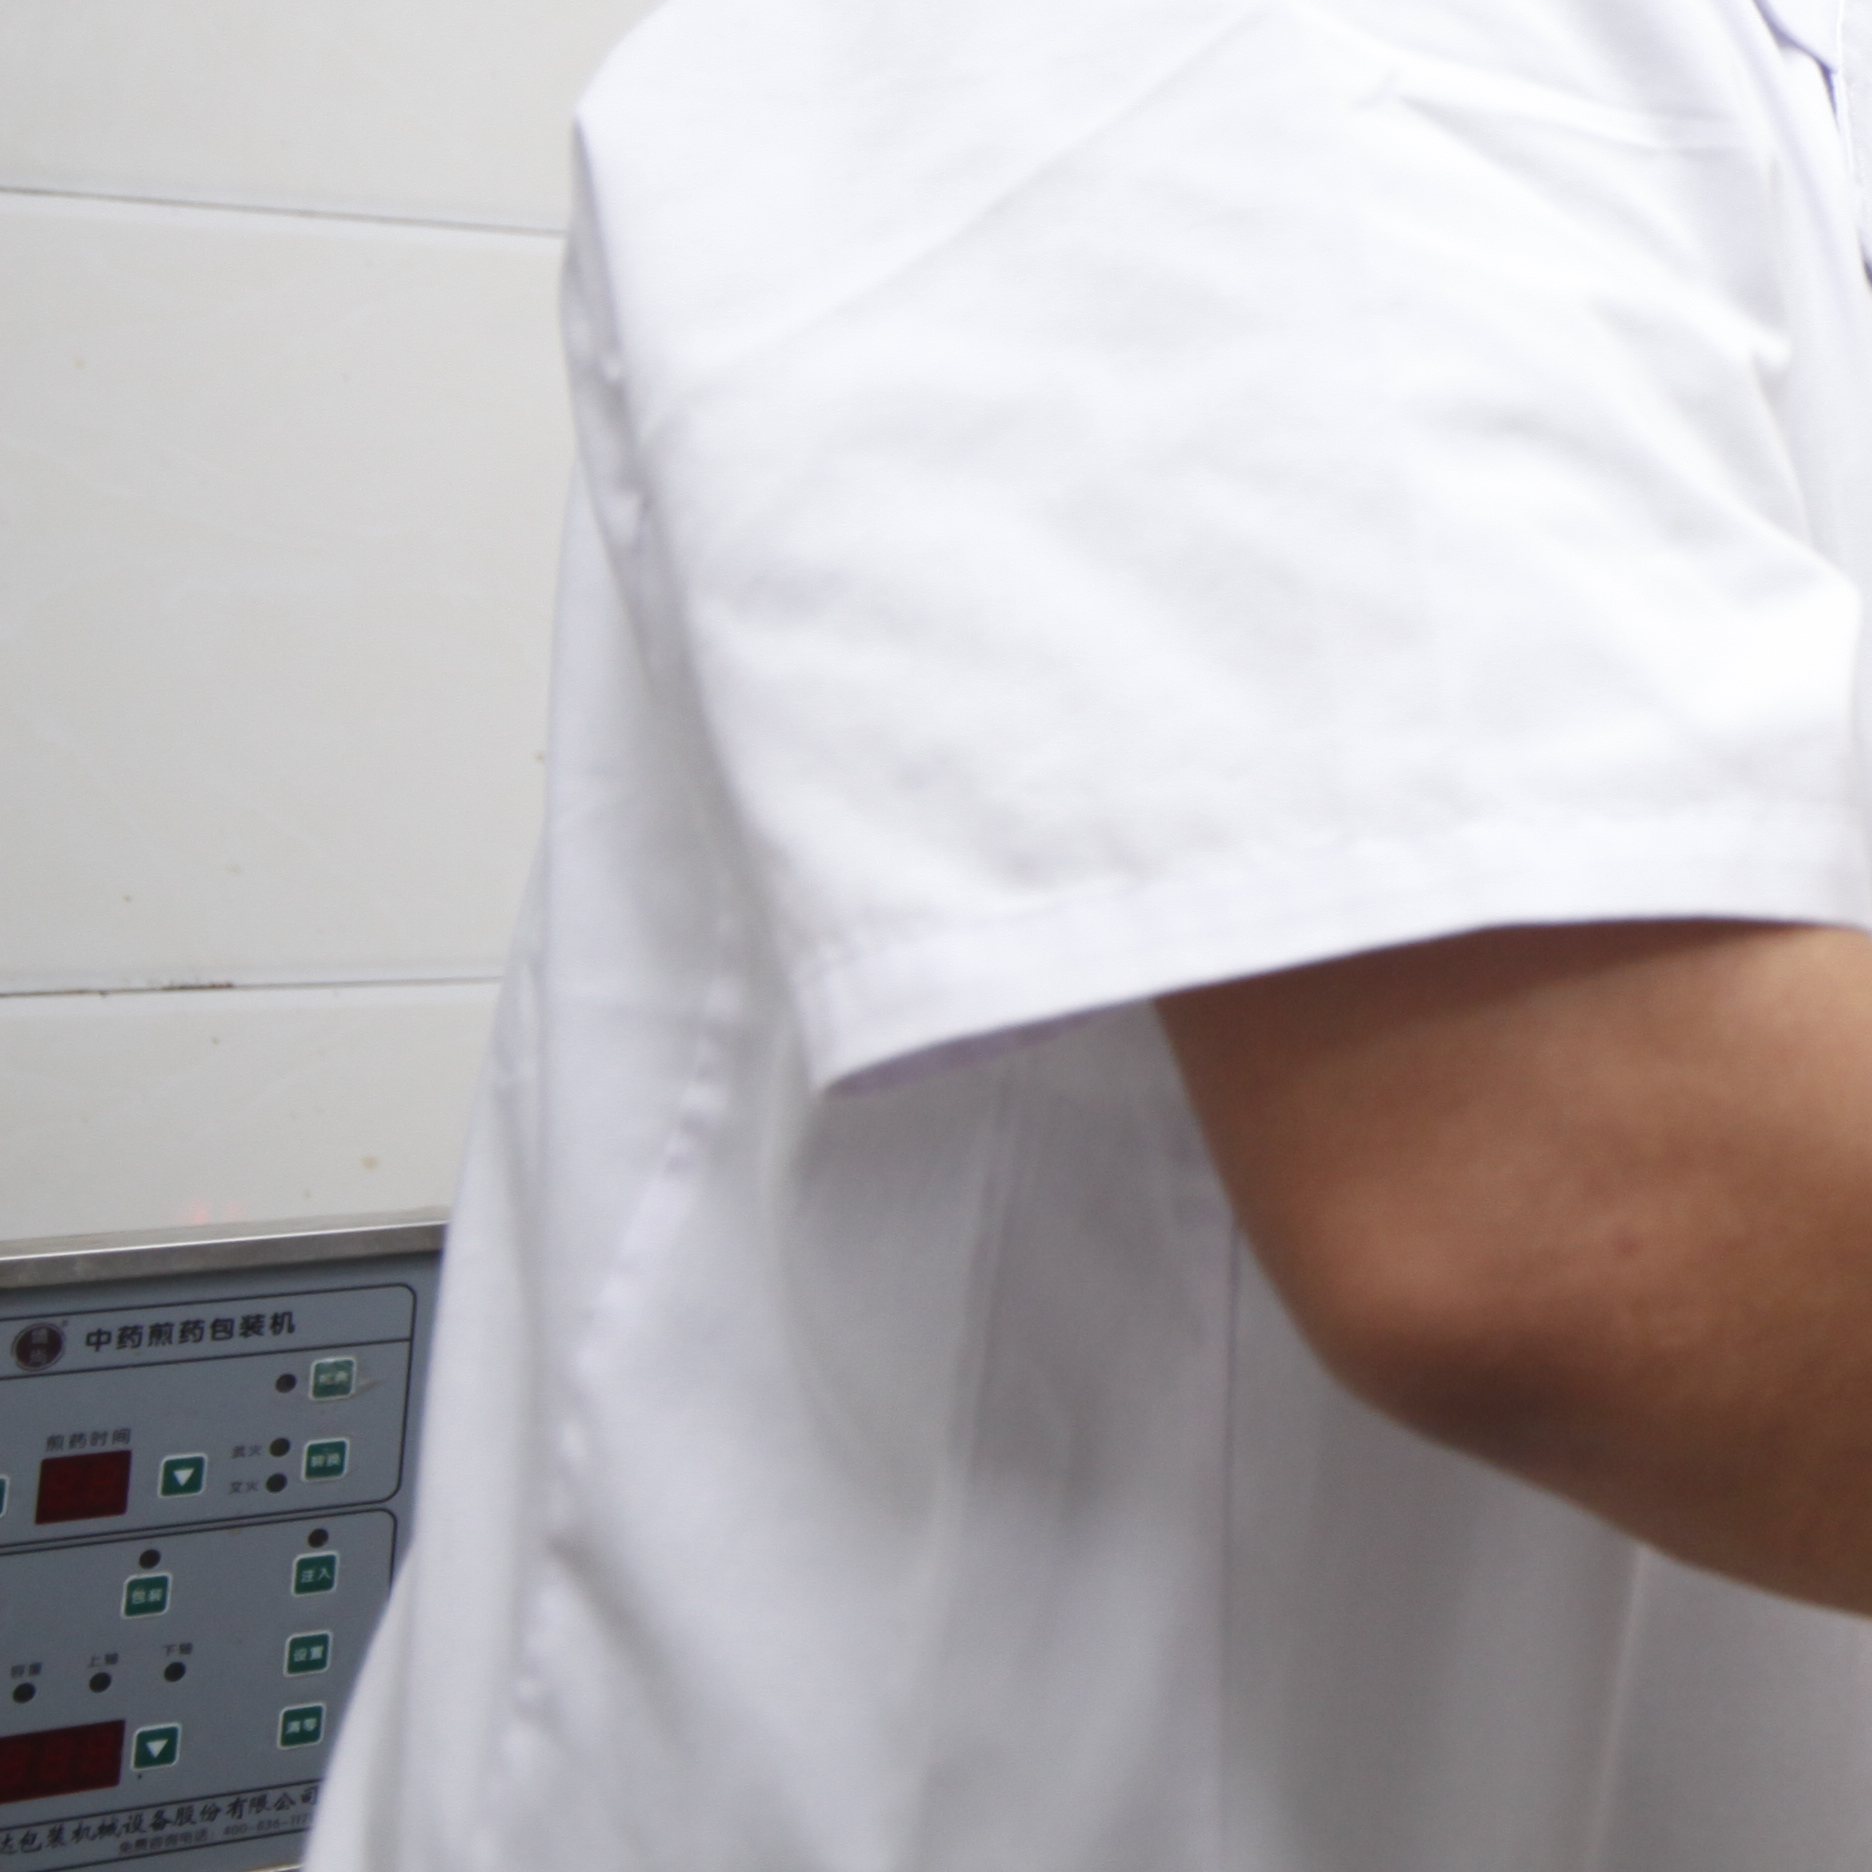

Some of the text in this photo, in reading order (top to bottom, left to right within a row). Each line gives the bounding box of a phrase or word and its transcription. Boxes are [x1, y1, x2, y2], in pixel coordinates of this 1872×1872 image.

[85, 1311, 297, 1352] 中药煎药包装机
[46, 1428, 131, 1452] 煎药时间
[301, 1567, 332, 1584] 注入
[131, 1587, 163, 1605] 包装
[293, 1645, 324, 1663] 设置
